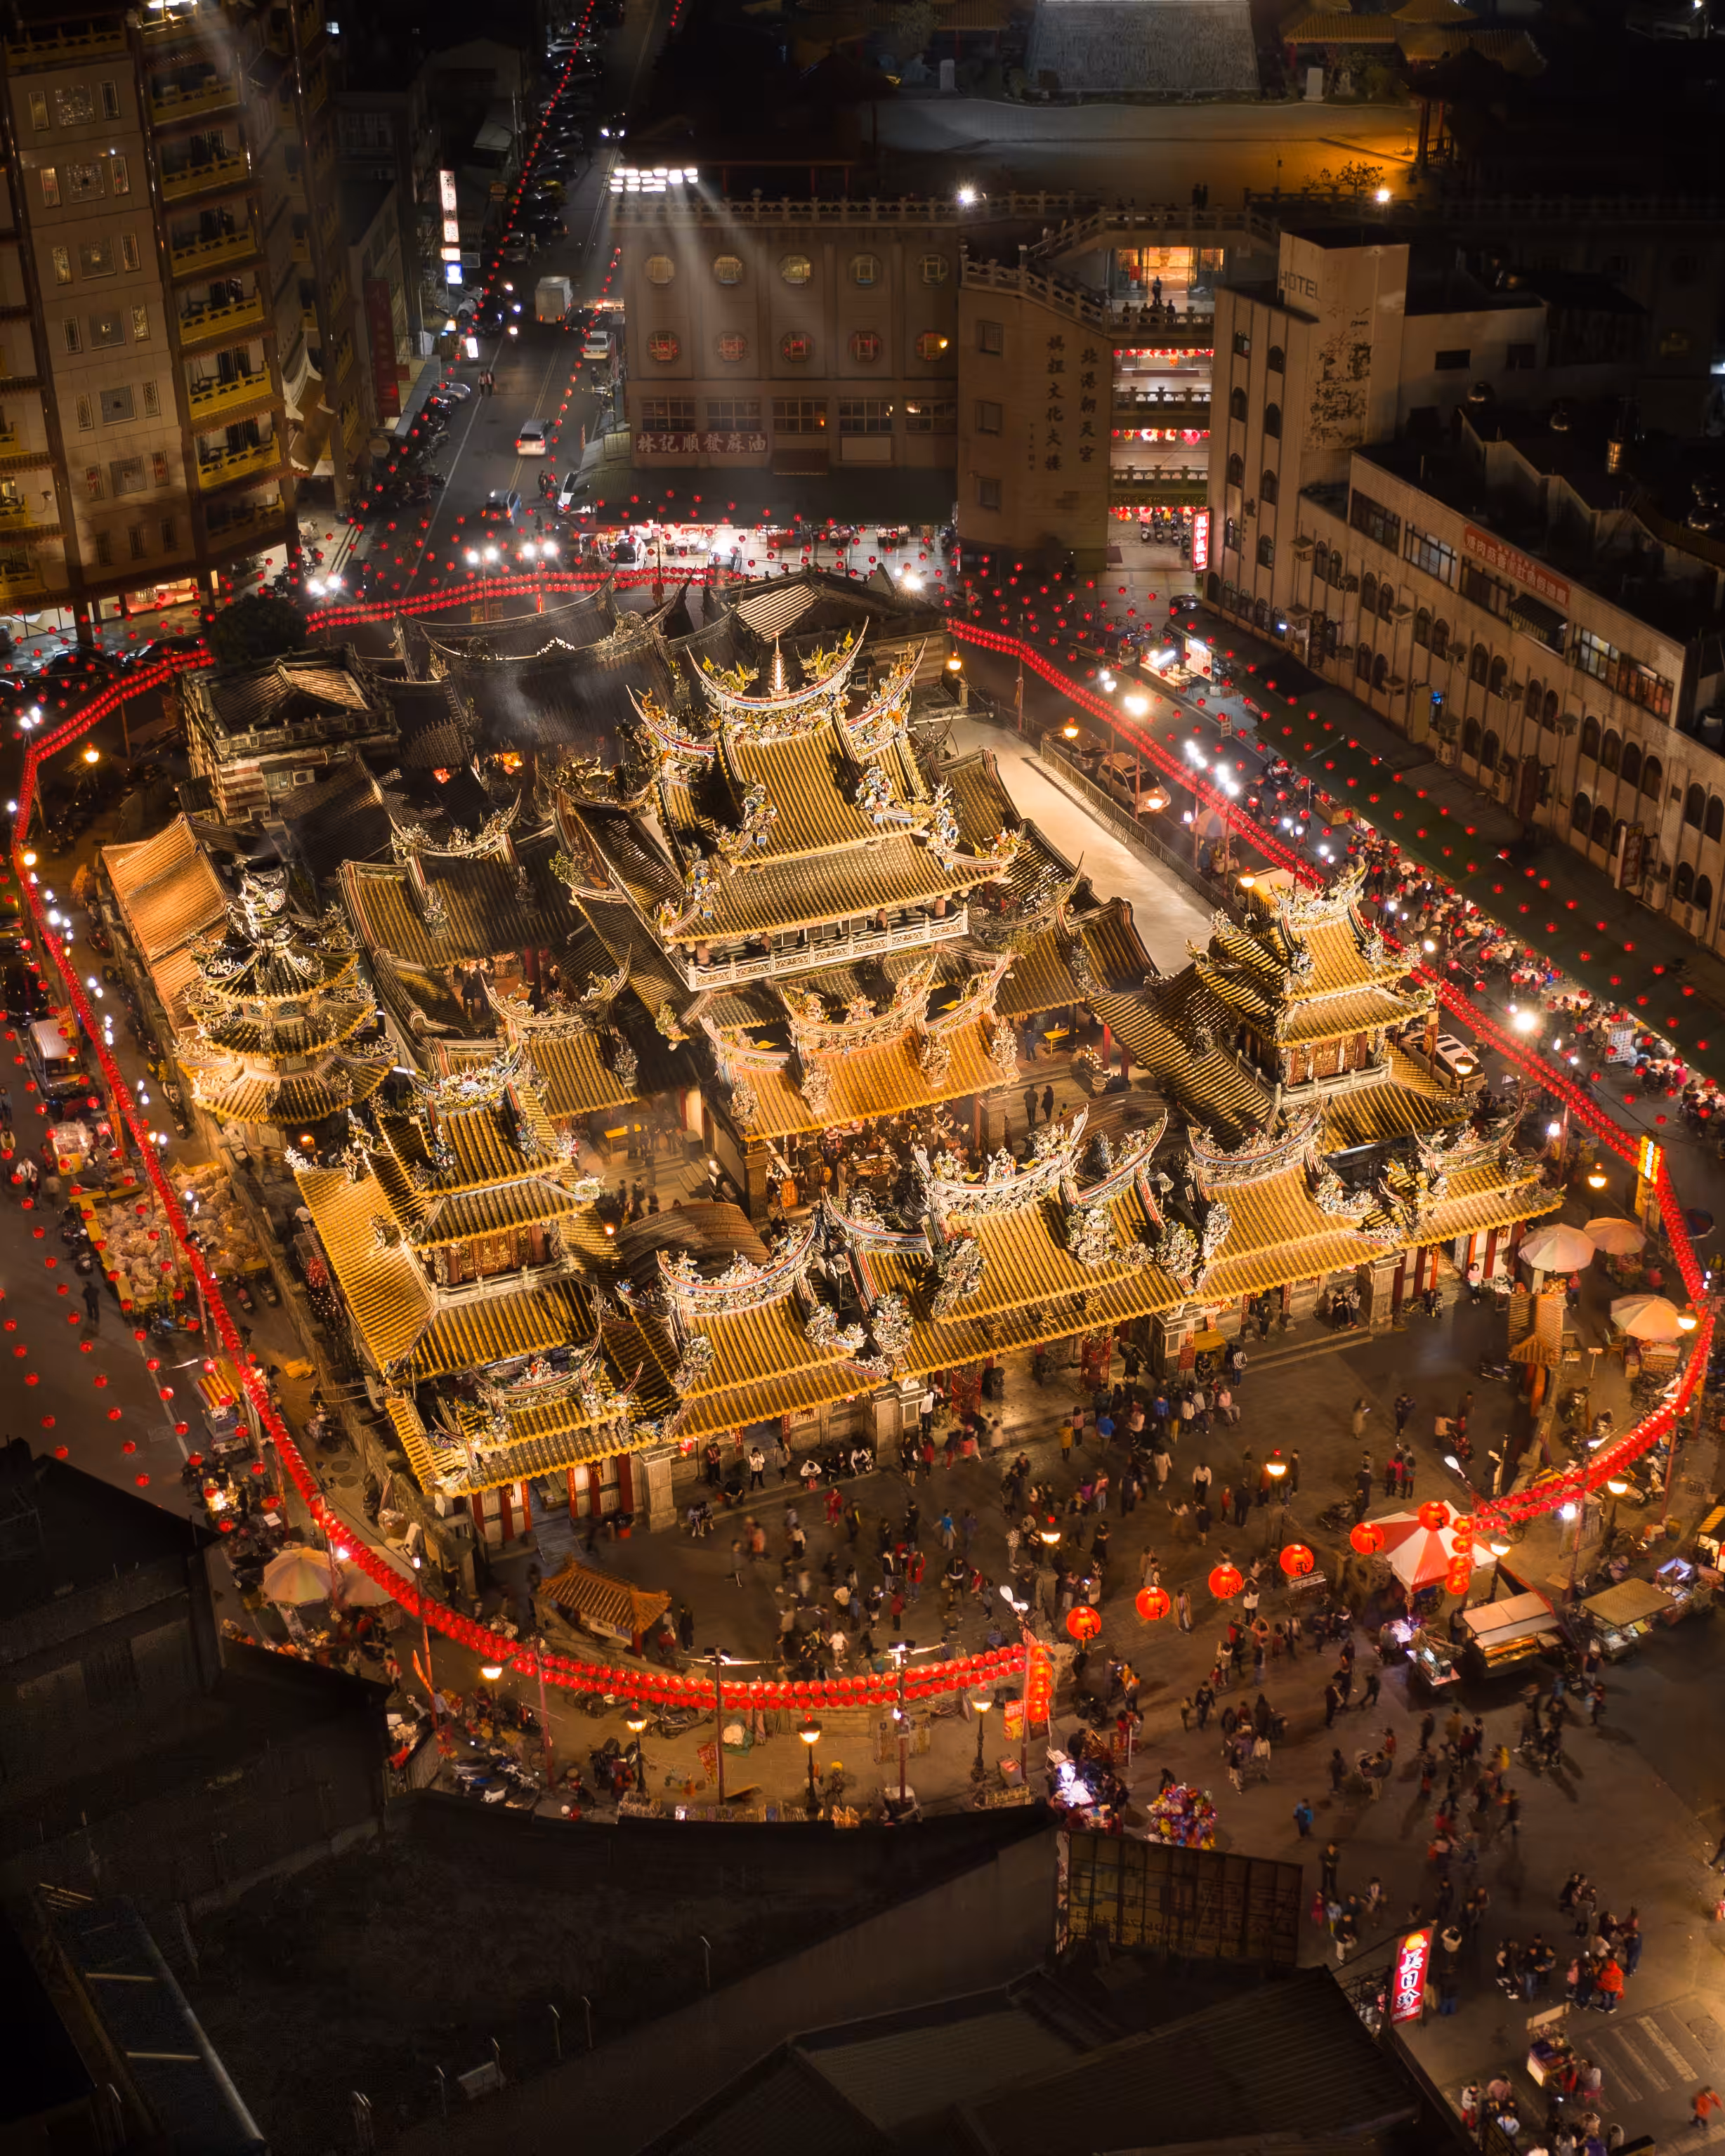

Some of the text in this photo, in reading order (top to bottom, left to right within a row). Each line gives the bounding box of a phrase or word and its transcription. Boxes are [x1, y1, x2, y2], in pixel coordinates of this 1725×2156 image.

[1279, 270, 1321, 302] HOTEL
[1079, 346, 1098, 464] 北港朝天宮
